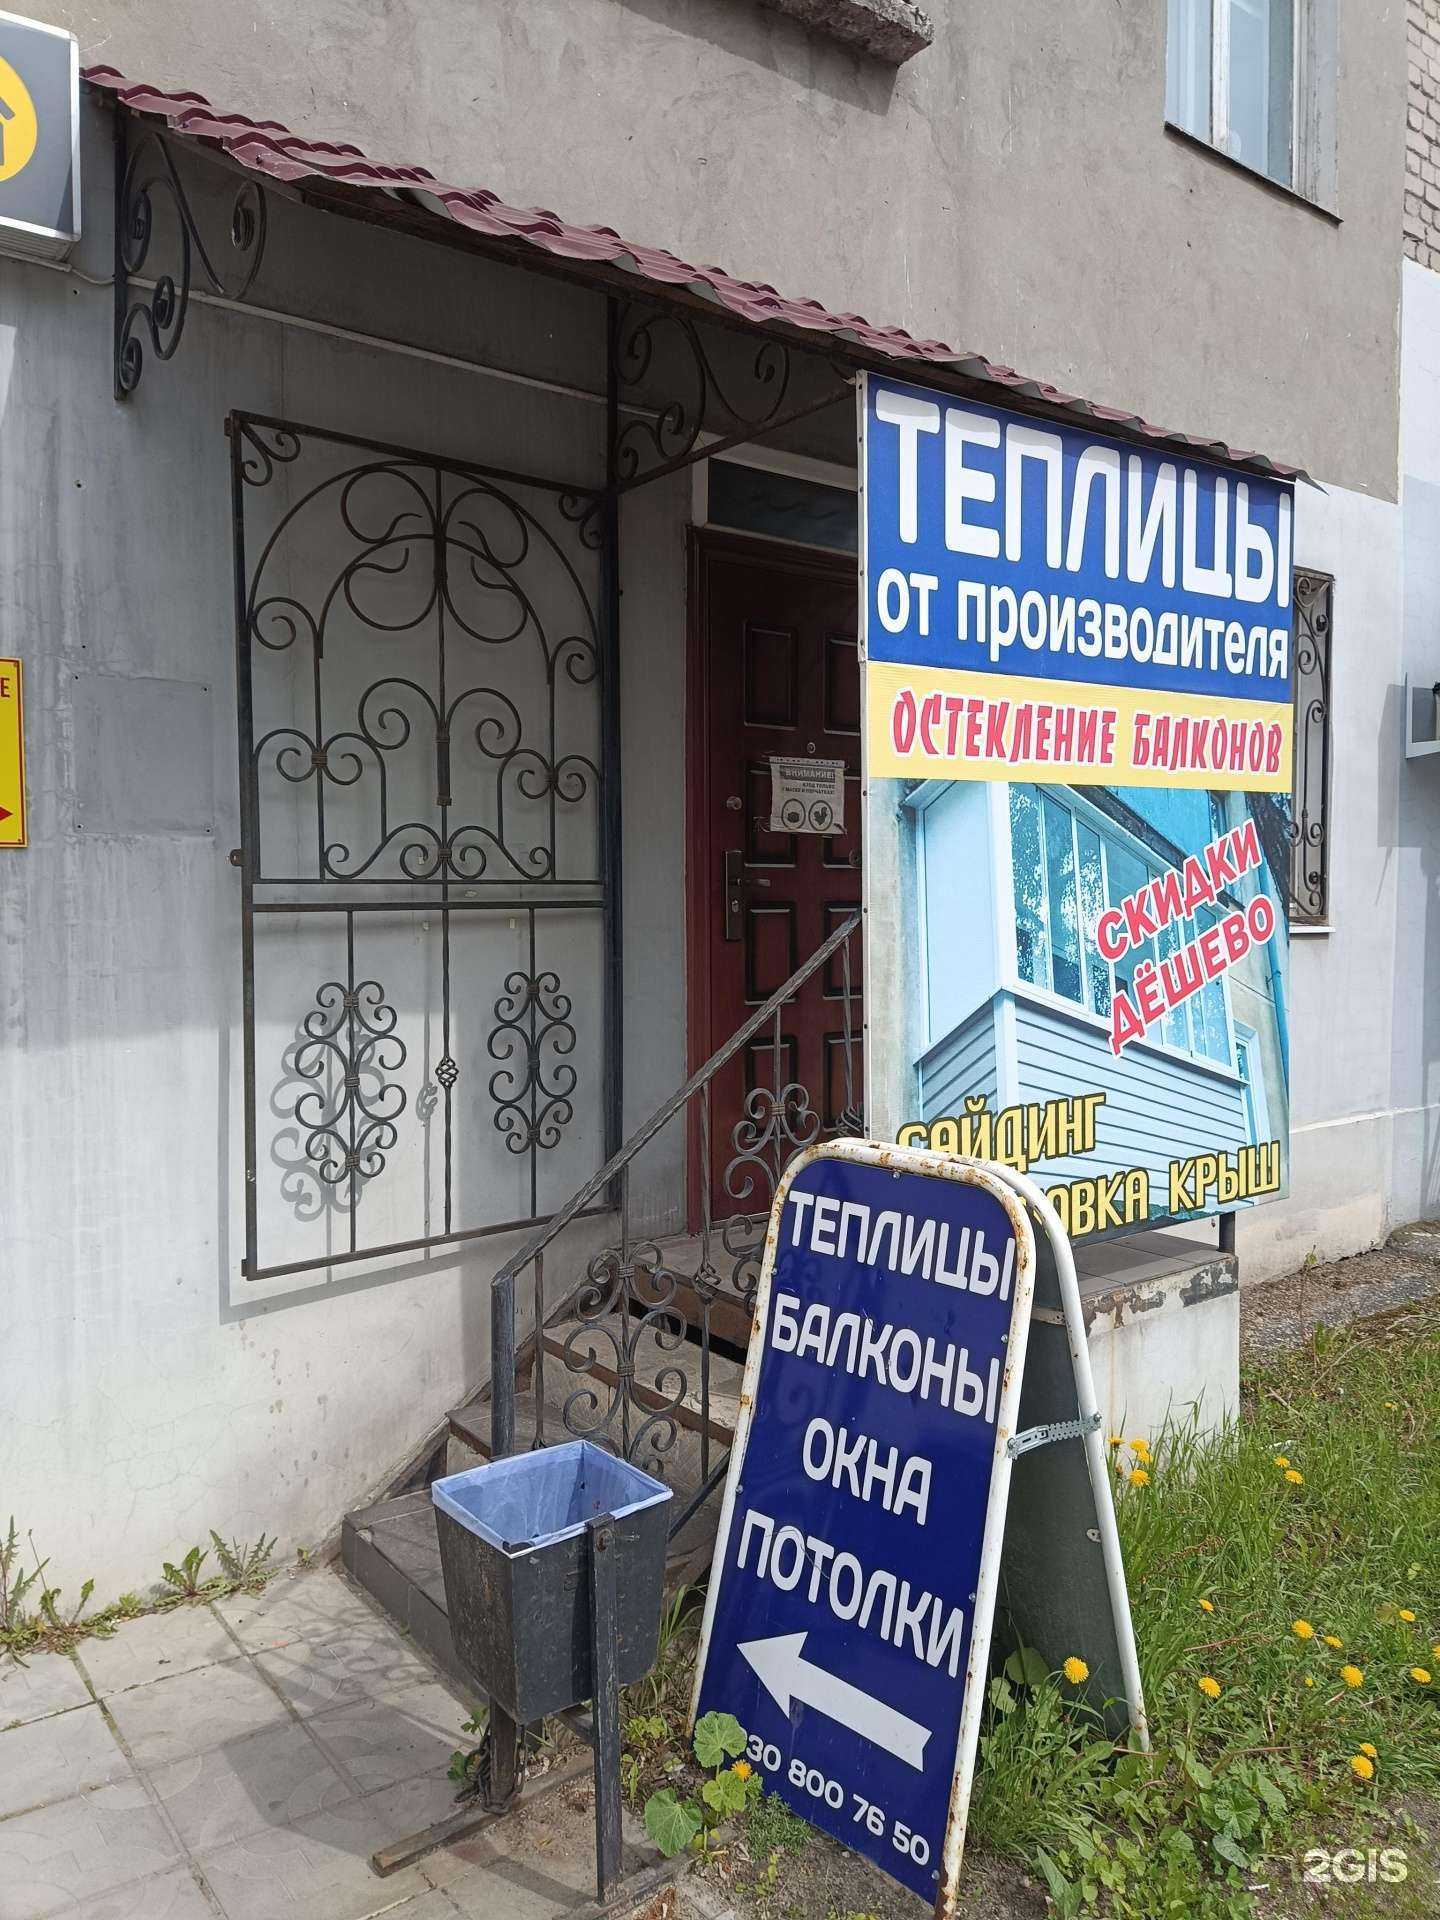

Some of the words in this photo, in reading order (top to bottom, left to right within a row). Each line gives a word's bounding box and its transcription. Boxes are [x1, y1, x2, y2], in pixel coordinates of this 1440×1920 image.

[875, 389, 1291, 608] ТЕПЛИЦЫ
[892, 690, 1118, 763] ОСТЕКЛЕНИЕ
[1132, 712, 1282, 773] БАЛКОНОВ
[1097, 821, 1262, 960] СКИДКИ
[1111, 897, 1274, 1056] ДЁШЕВО
[1168, 1140, 1280, 1215] КРЫШ
[788, 1190, 1016, 1301] ТЕПЛИЦЫ
[771, 1293, 1000, 1424] БАЛКОНЫ
[802, 1417, 932, 1526] ОКНА
[736, 1508, 964, 1679] ПОТОЛКИ
[740, 1726, 782, 1772] 30
[787, 1758, 844, 1809] 800
[852, 1793, 886, 1837] 76
[892, 1820, 930, 1867] 50
